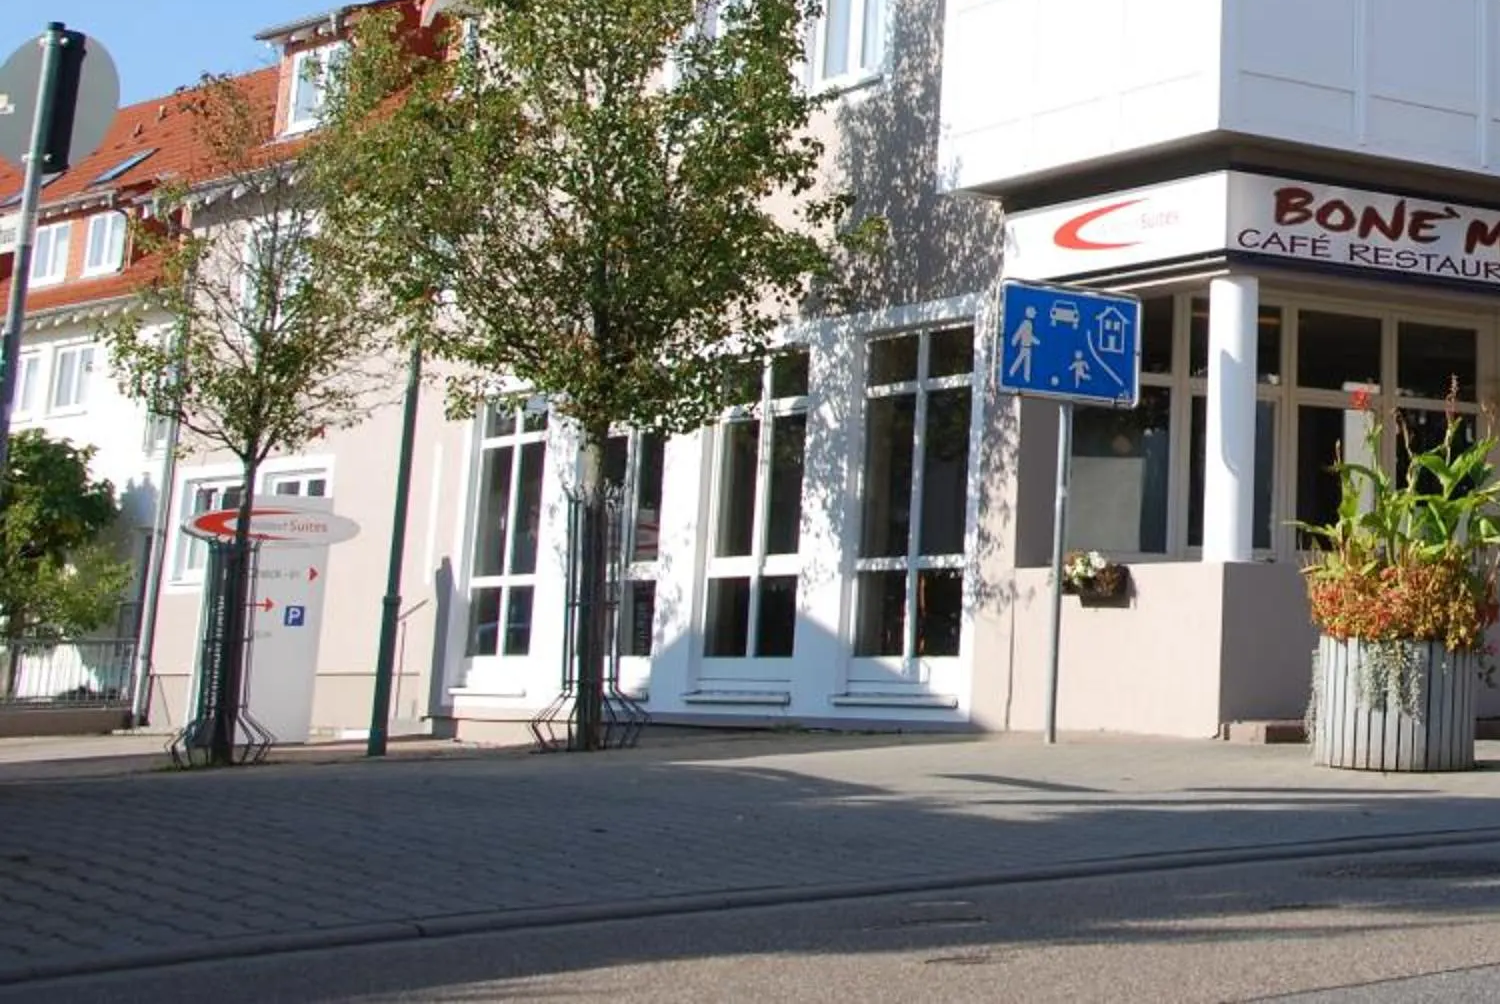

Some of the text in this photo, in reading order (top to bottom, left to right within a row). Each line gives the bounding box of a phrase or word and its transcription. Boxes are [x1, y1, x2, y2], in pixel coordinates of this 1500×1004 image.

[1237, 228, 1332, 258] CAFÉ
[290, 519, 328, 533] Suites
[287, 607, 301, 624] P
